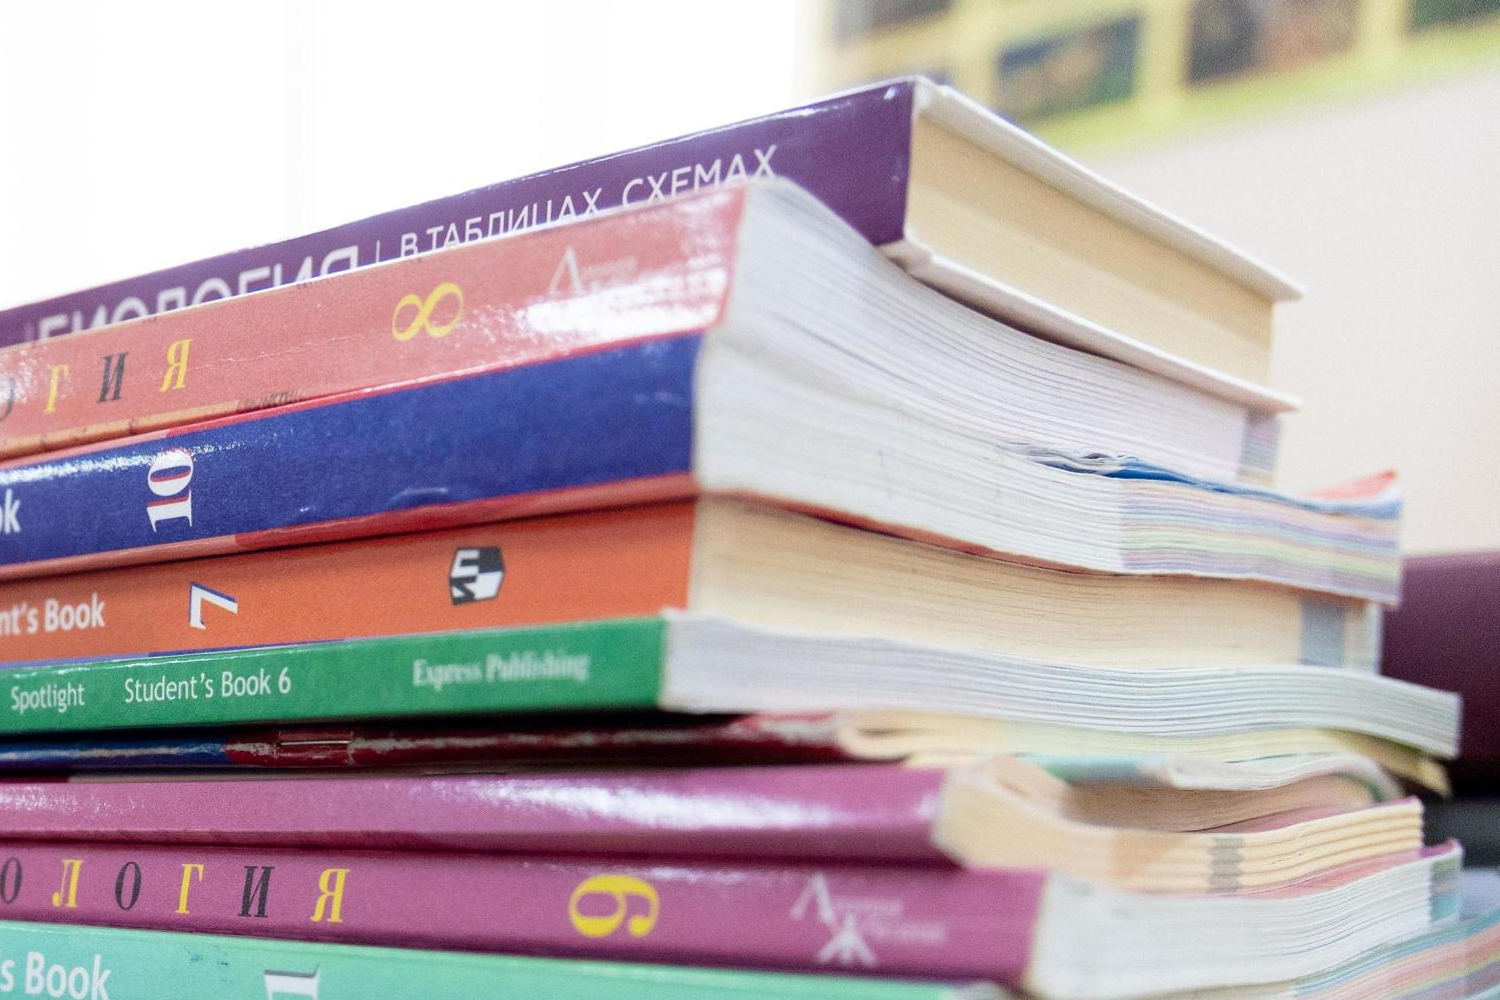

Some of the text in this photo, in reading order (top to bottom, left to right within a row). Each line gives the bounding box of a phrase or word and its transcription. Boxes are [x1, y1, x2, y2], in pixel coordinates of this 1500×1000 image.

[401, 232, 419, 258] В
[426, 187, 603, 248] ТАБЛИЦАХ
[623, 144, 777, 209] СХЕМАХ
[148, 449, 194, 533] 10
[44, 593, 105, 633] Book
[189, 581, 238, 629] 7
[10, 682, 85, 714] Spotlight
[124, 673, 214, 704] Student's
[221, 668, 272, 698] Book
[277, 667, 292, 695] 6
